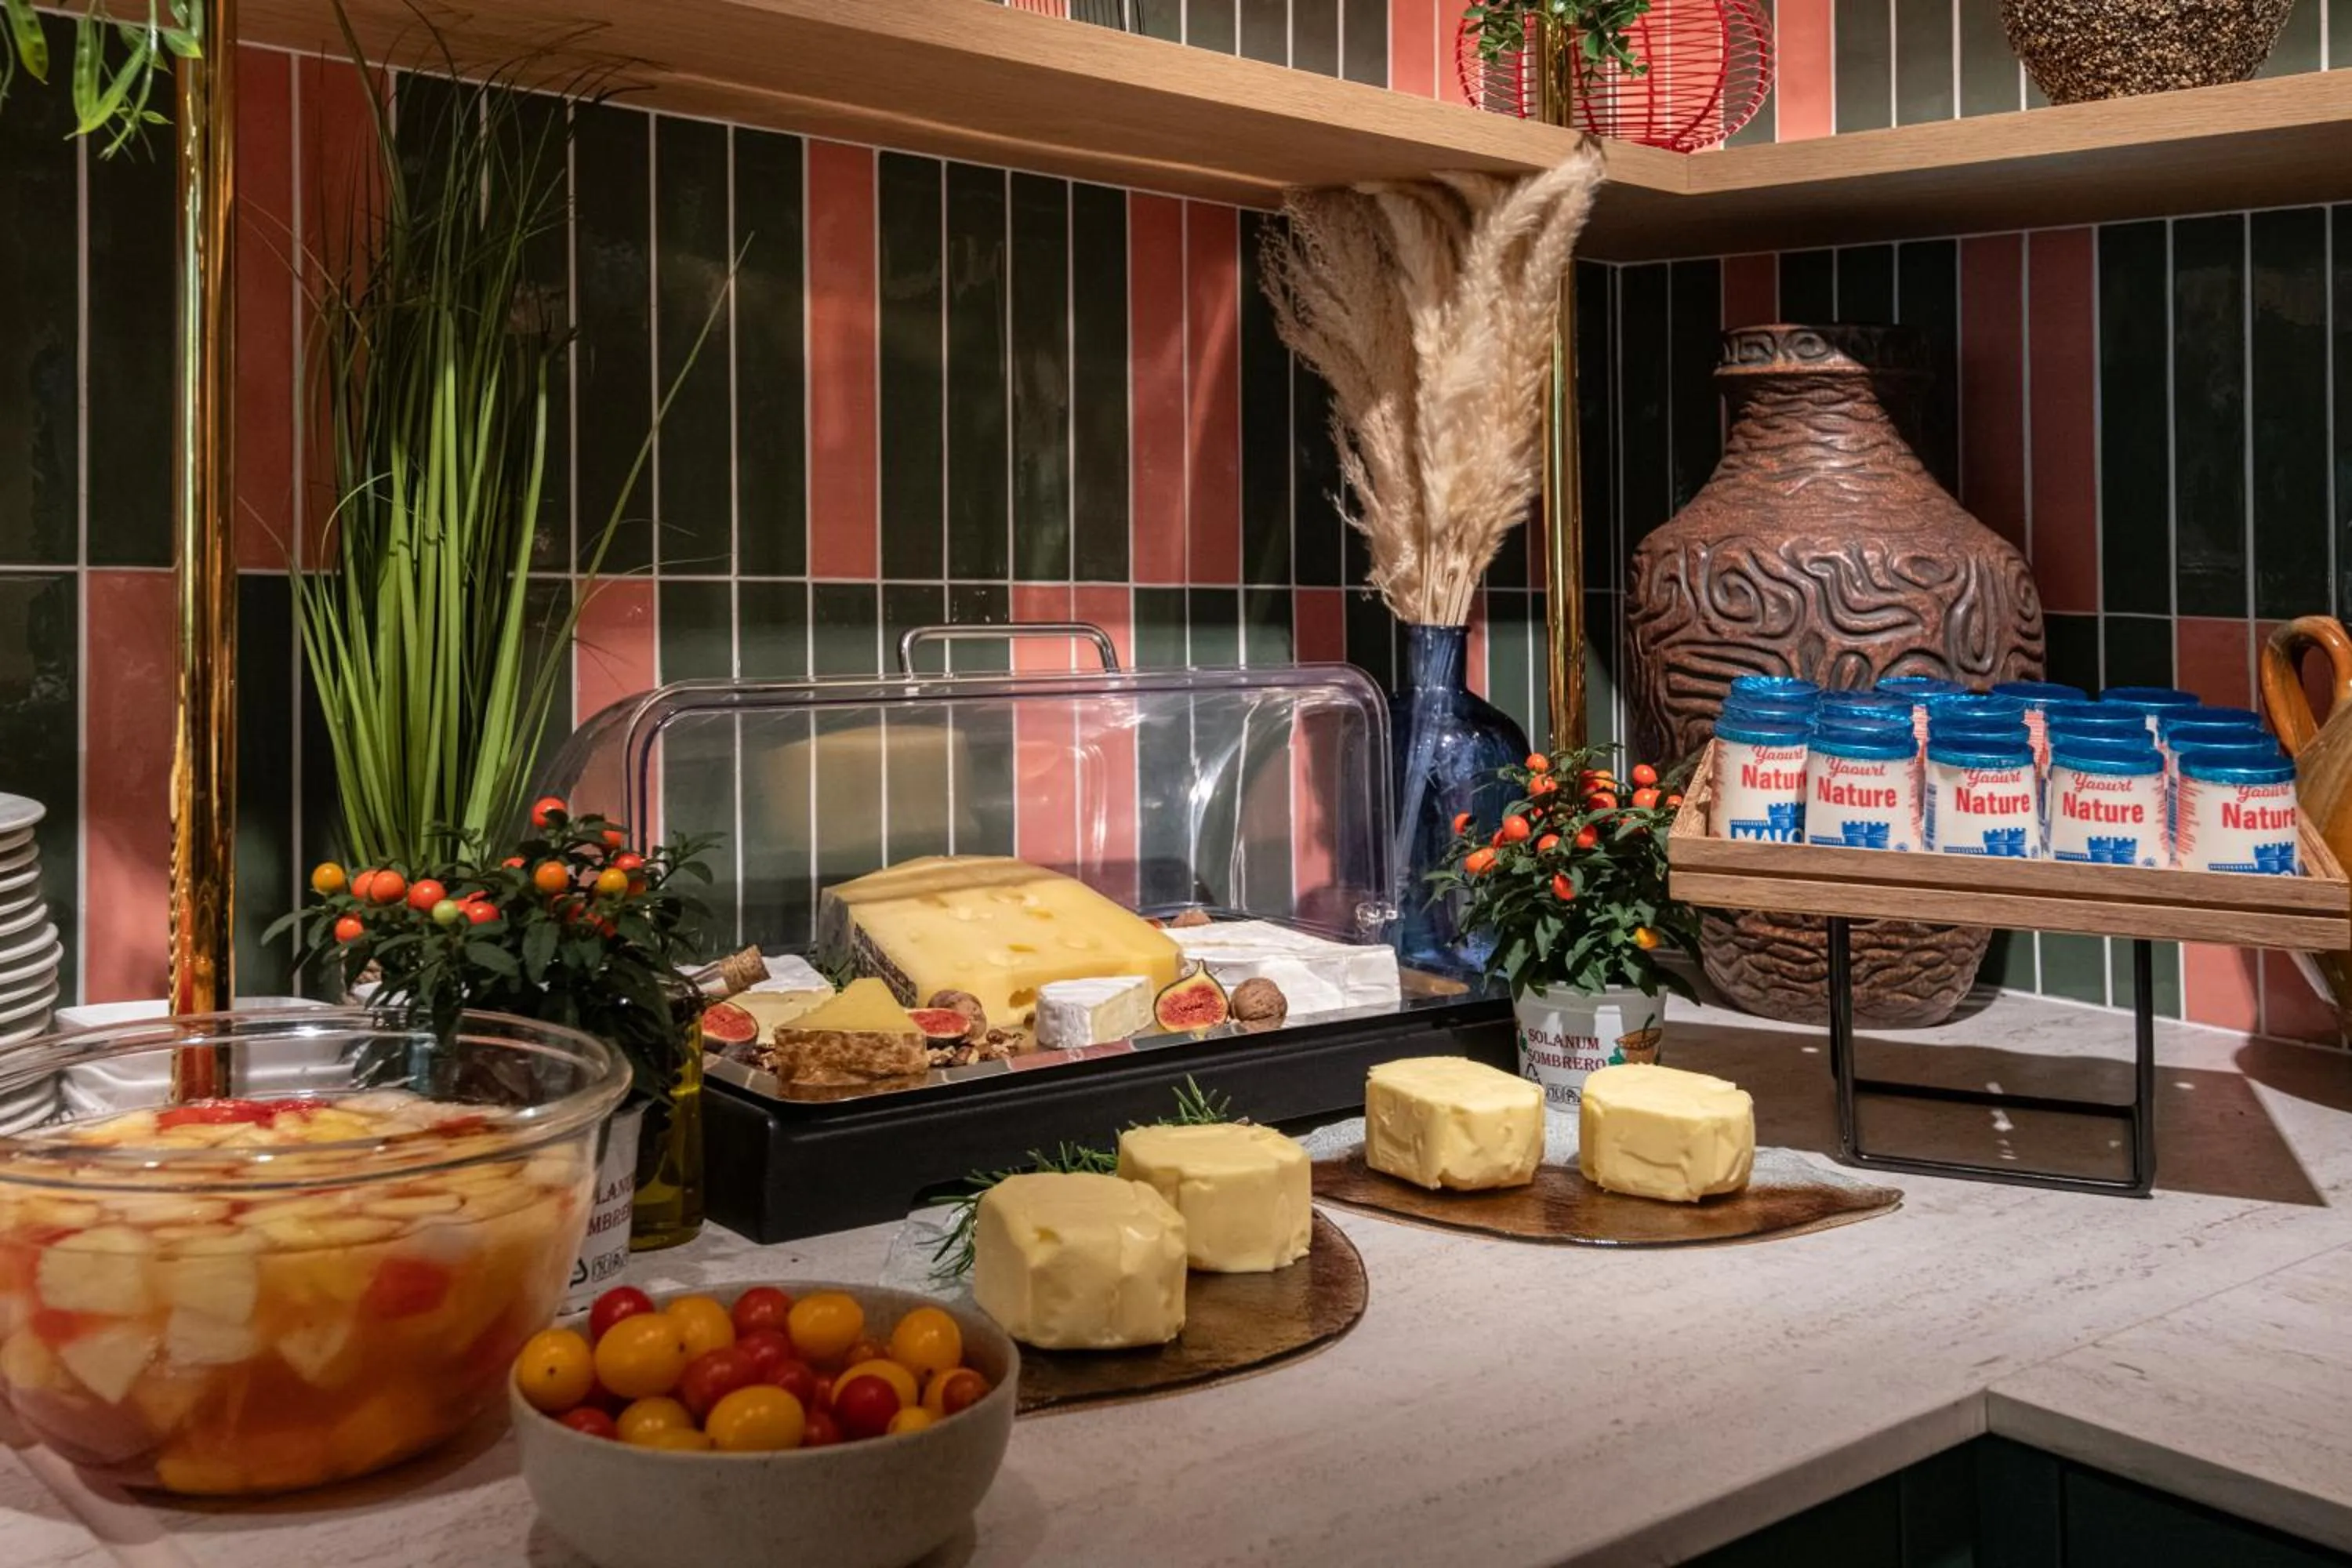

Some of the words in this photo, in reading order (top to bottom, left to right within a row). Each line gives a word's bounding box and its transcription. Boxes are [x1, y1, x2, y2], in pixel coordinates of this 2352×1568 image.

[1825, 756, 1887, 778] Yaourt
[1817, 776, 1896, 808] Nature
[2071, 771, 2132, 792] Yaourt
[1956, 786, 2031, 814] Nature
[2063, 791, 2144, 823] Nature
[1528, 1028, 1599, 1051] SOLANUM
[1526, 1048, 1606, 1072] SOMBRERO
